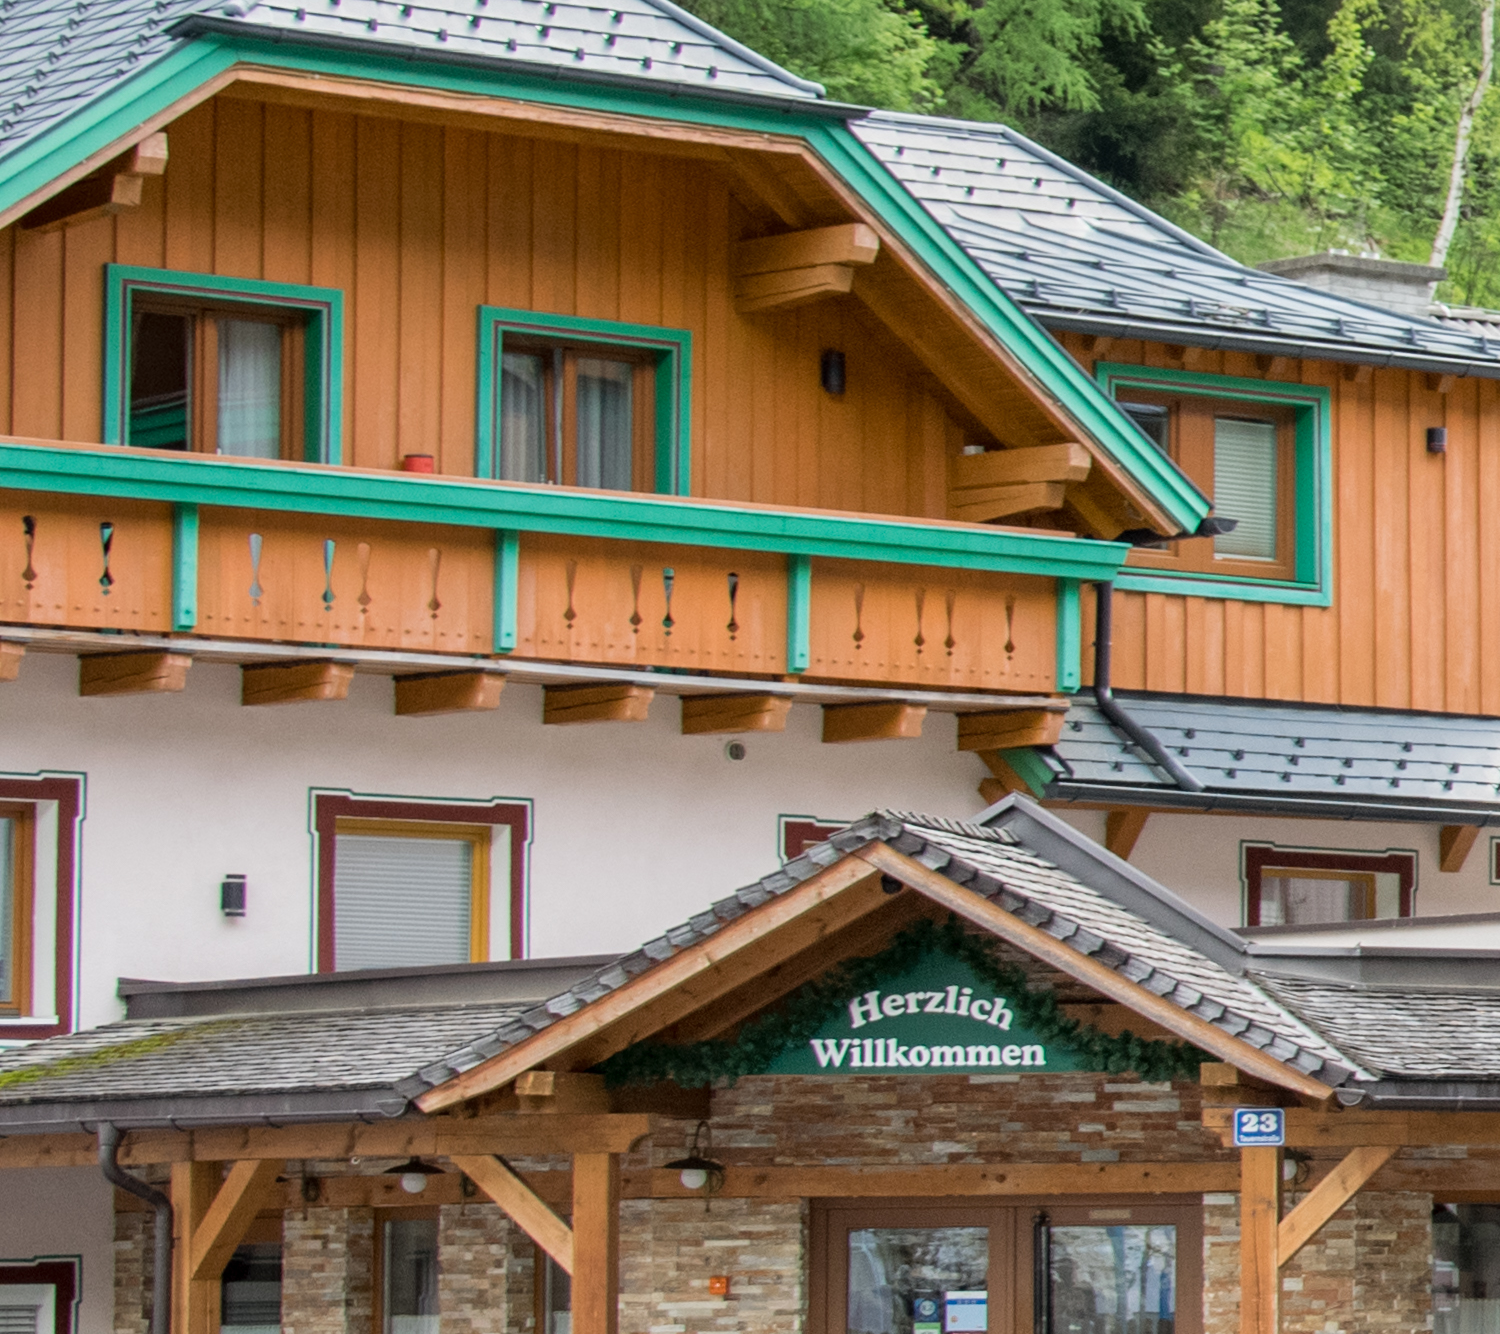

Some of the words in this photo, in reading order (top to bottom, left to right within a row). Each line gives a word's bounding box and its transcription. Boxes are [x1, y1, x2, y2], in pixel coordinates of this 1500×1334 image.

[847, 984, 1016, 1031] Herzlich
[809, 1036, 1047, 1068] Willkommen
[1240, 1112, 1278, 1134] 23
